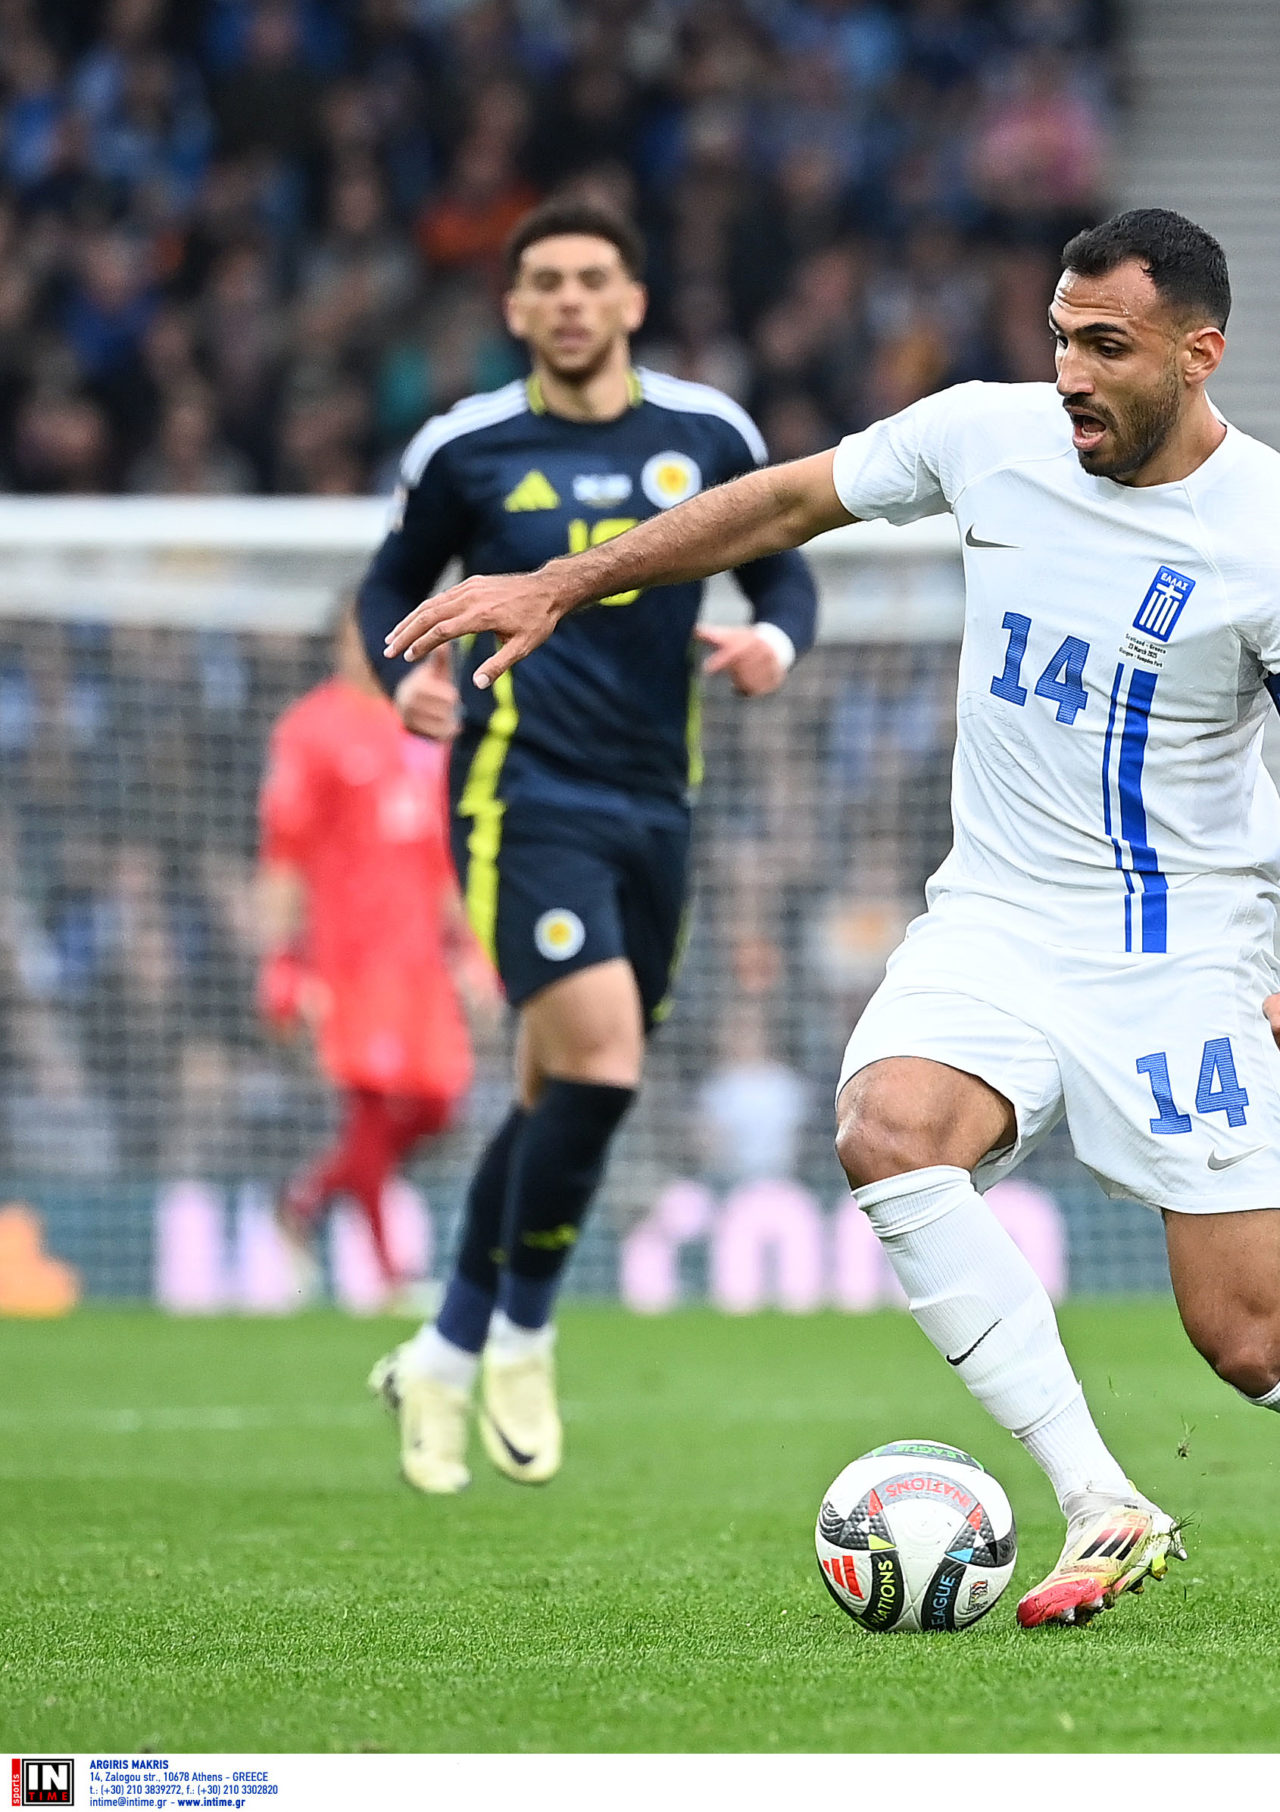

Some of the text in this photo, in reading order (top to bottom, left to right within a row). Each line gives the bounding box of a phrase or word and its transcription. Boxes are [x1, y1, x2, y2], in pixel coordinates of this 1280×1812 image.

[1160, 572, 1189, 591] ΕΛΛΑΣ
[990, 611, 1091, 726] 14
[1136, 1037, 1249, 1134] 14
[893, 1445, 967, 1462] LEAGUE
[885, 1478, 972, 1508] NATIONS
